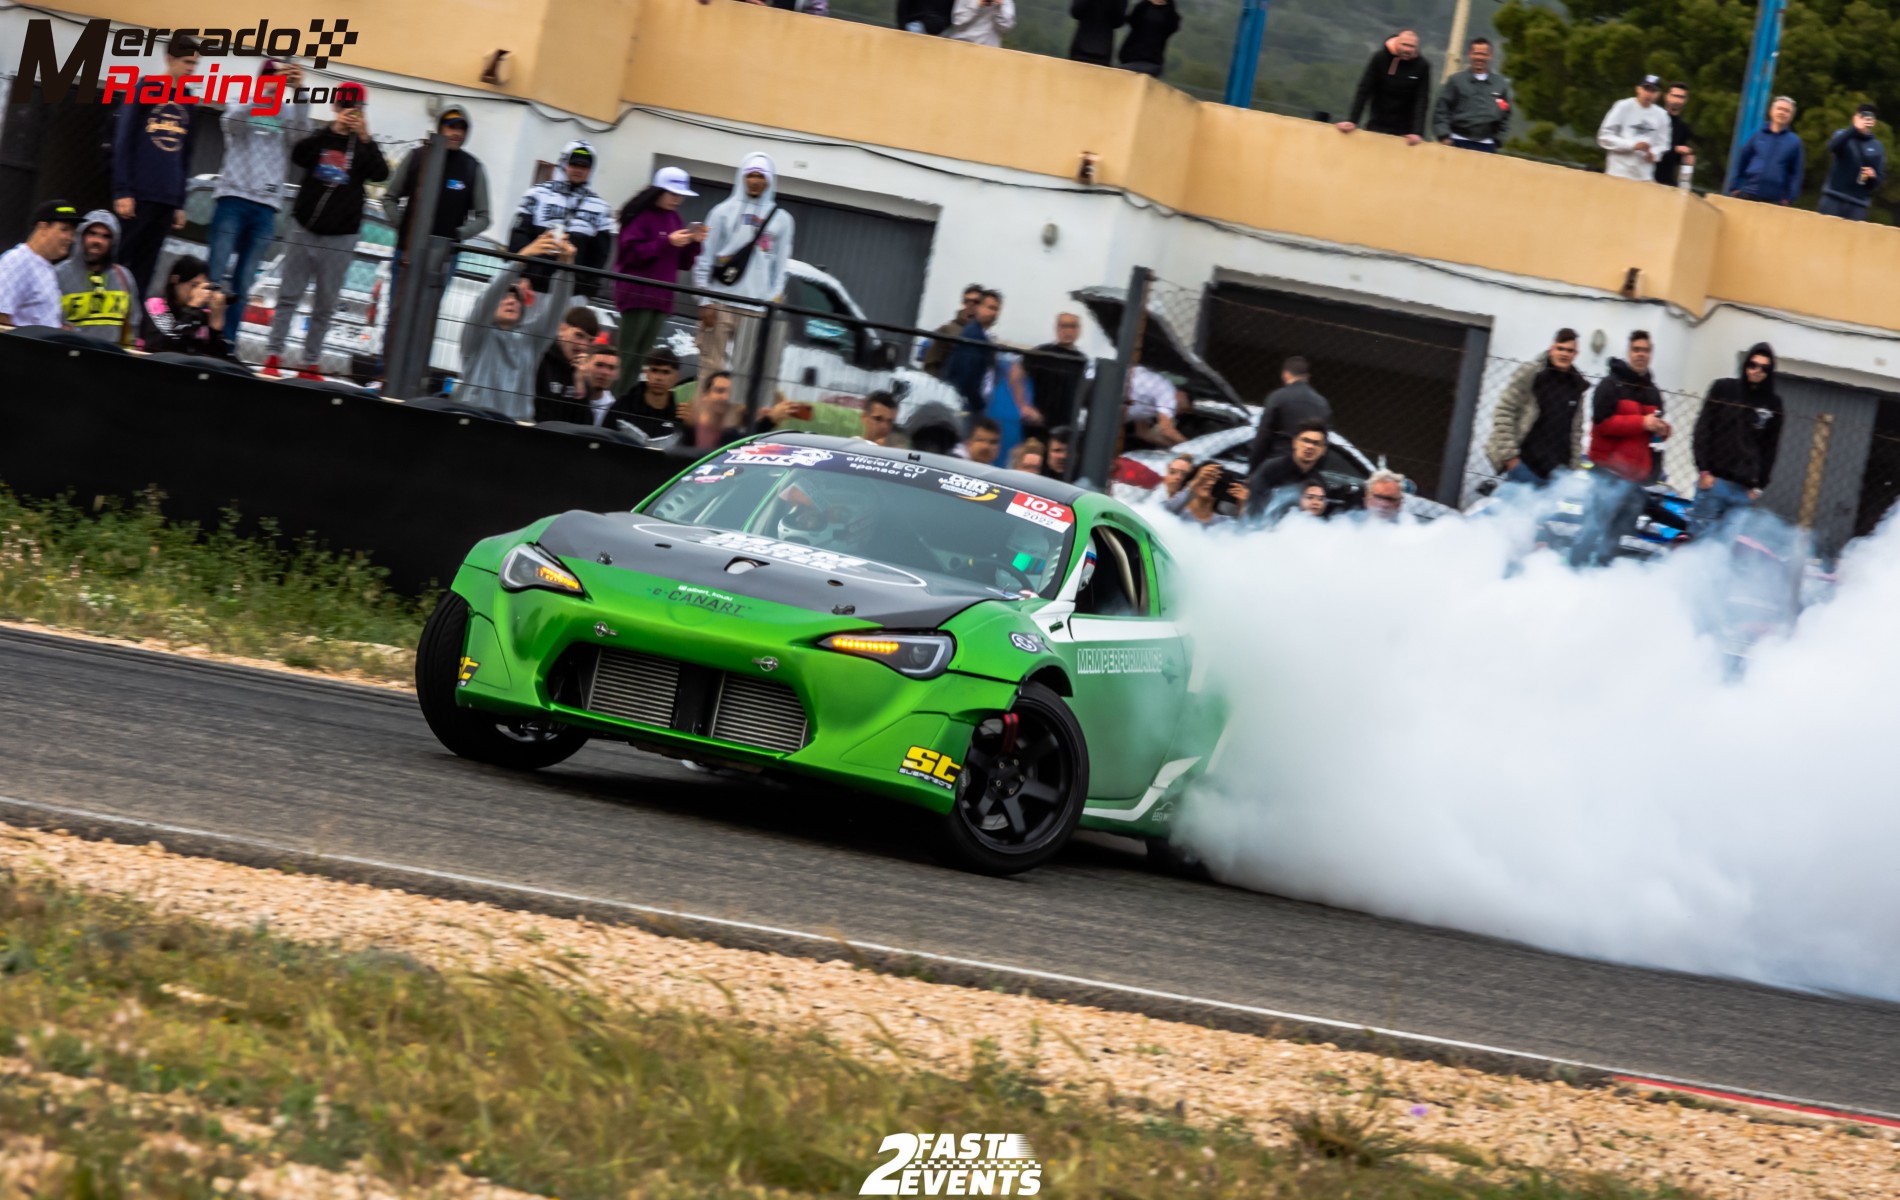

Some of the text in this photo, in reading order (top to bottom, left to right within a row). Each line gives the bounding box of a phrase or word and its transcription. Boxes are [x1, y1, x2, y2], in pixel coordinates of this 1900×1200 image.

[846, 456, 928, 474] official ECU
[849, 463, 901, 475] sponsor
[1023, 496, 1065, 518] 105
[1022, 510, 1054, 526] 2022
[458, 656, 479, 680] t
